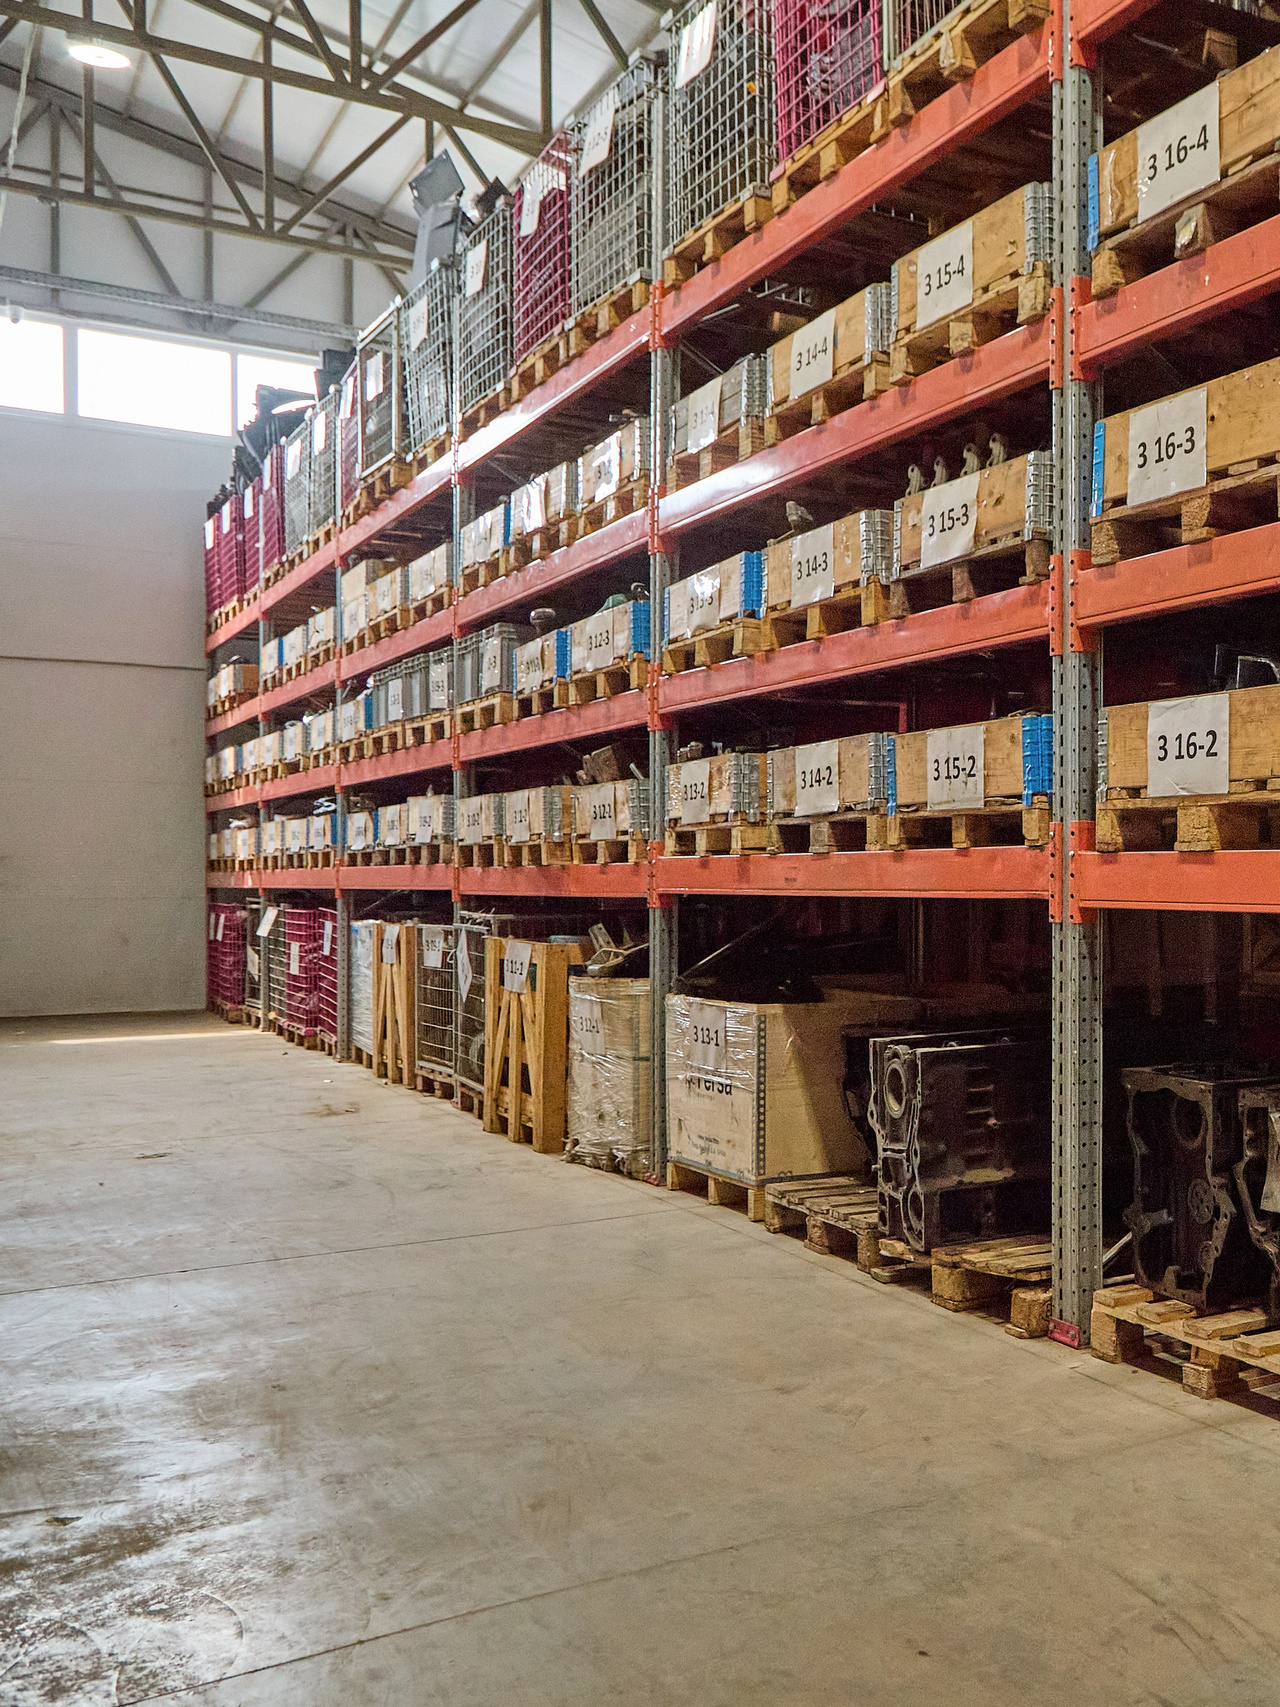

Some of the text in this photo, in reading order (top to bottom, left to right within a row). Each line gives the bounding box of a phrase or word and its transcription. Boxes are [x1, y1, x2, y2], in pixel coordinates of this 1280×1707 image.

[1148, 124, 1209, 181] 3 16-4
[924, 254, 965, 296] 3 15-4
[796, 336, 828, 372] 3 14-4
[1137, 426, 1196, 469] 3 16-3
[928, 503, 970, 538] 3 15-3
[796, 550, 828, 581] 3 14-3
[588, 629, 610, 651] 3 12-3
[1157, 729, 1218, 762] 3 16-2
[801, 765, 833, 790] 3 14-2
[933, 755, 977, 782] 3 15-2
[684, 781, 705, 801] 3 13-2
[593, 803, 612, 820] 3 12-2
[579, 1016, 600, 1033] 3 12-1
[693, 1025, 720, 1047] 3 13-1
